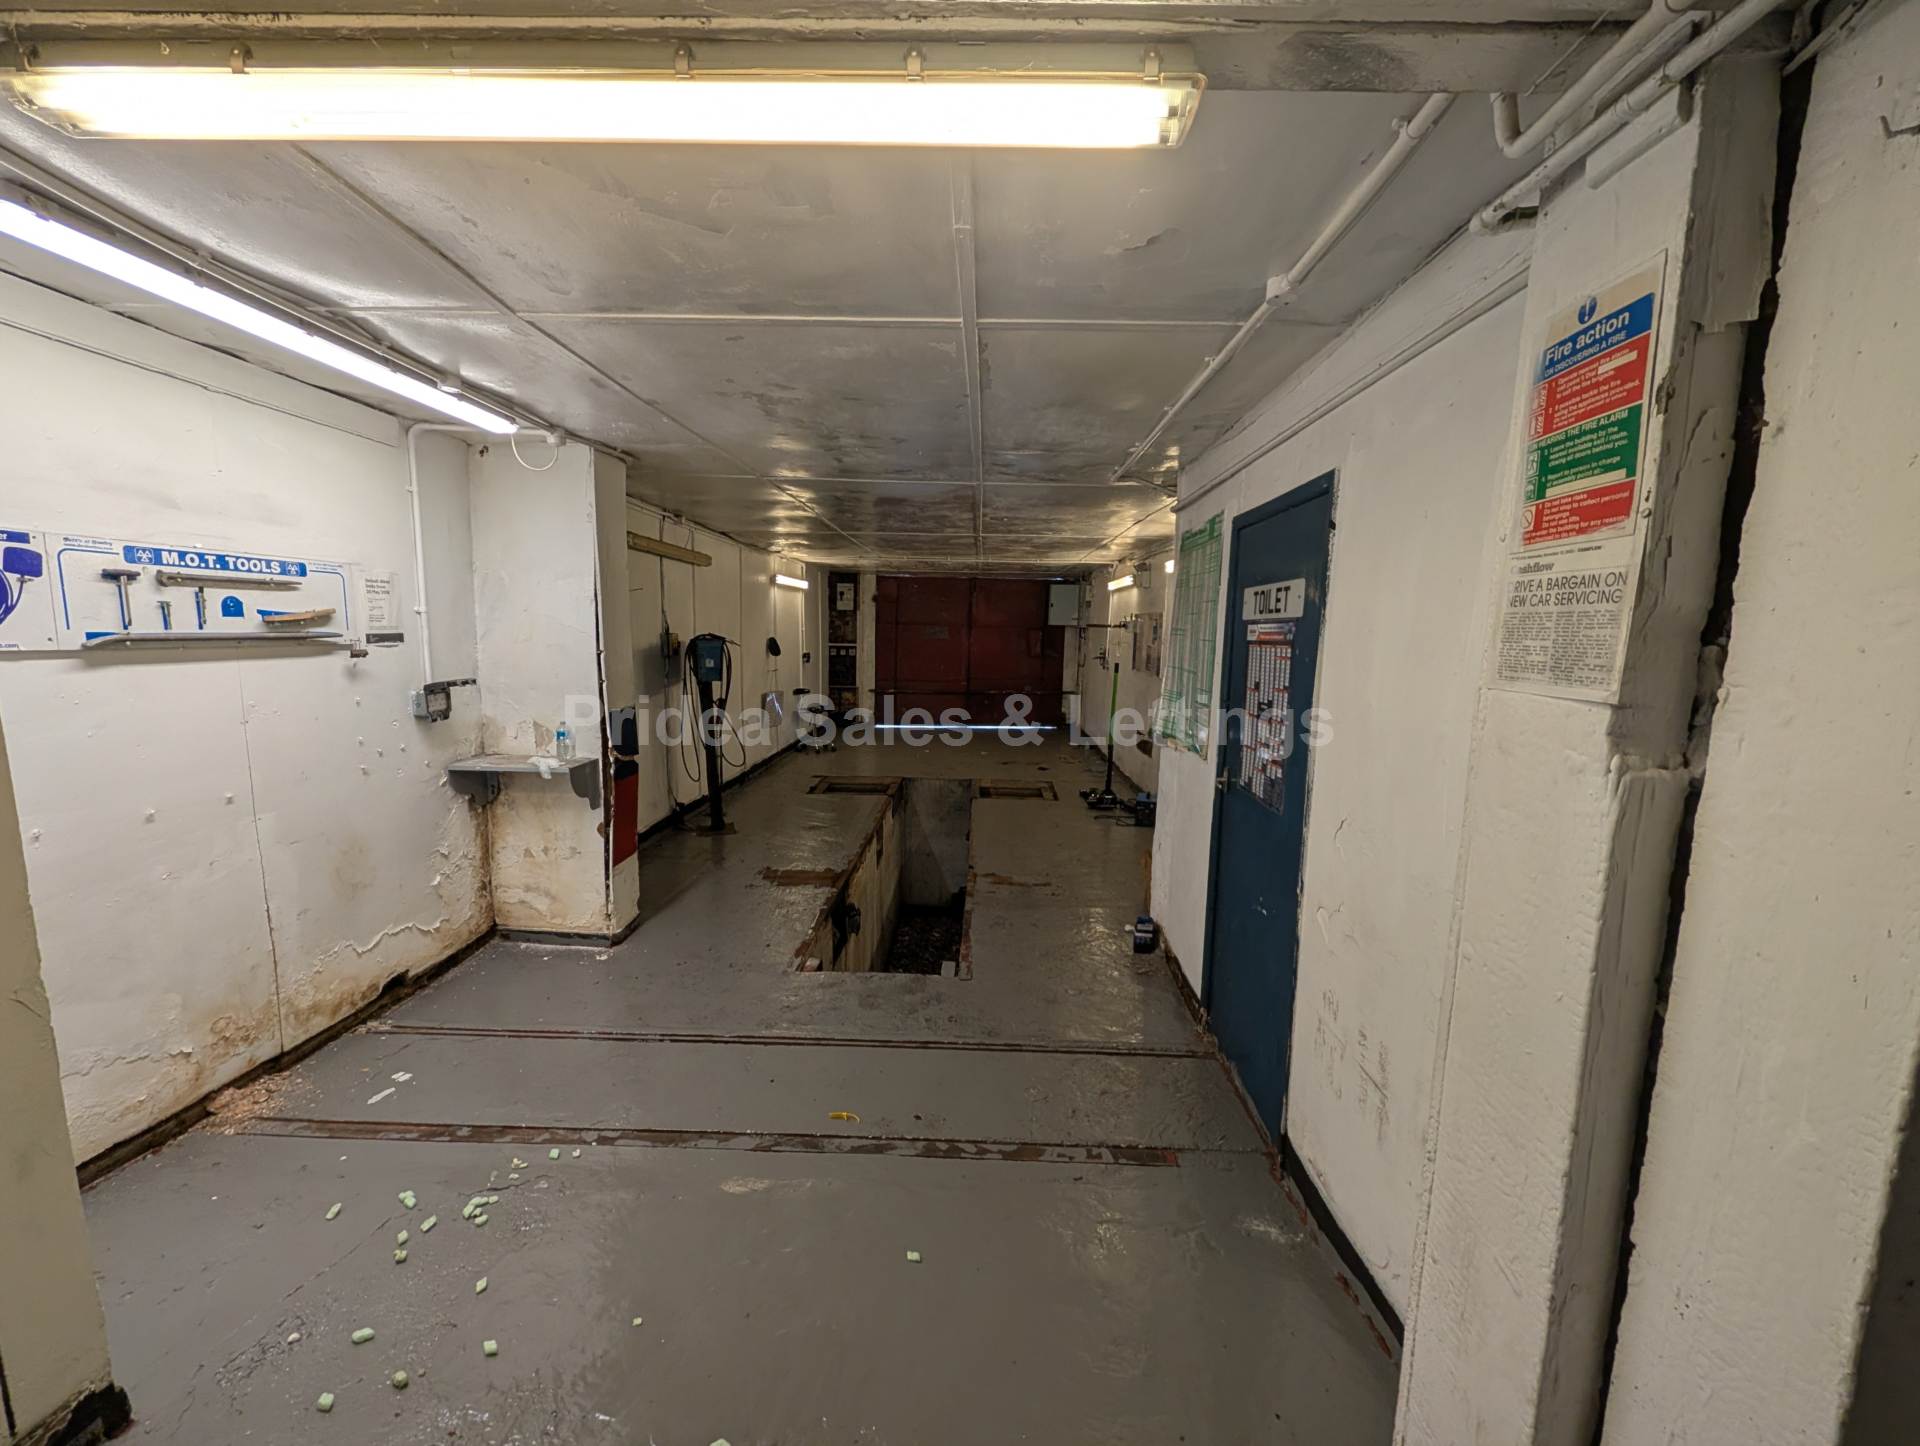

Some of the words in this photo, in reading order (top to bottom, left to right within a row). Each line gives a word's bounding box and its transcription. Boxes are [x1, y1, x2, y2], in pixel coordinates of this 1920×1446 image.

[1545, 342, 1572, 366] Fire
[1576, 312, 1629, 349] action
[1545, 367, 1554, 377] ON
[1554, 344, 1600, 374] DISCOVERING
[1600, 340, 1607, 350] A
[1607, 330, 1627, 346] FIRE
[1566, 426, 1581, 438] THE
[1581, 419, 1597, 433] FIRE
[1599, 408, 1628, 427] ALARM
[162, 551, 220, 569] M.O.T.
[225, 556, 281, 574] TOOLS
[1536, 578, 1543, 592] A
[1546, 573, 1601, 591] BARGAIN
[1604, 571, 1629, 587] ON
[1253, 585, 1291, 616] TOILET
[1529, 593, 1552, 607] CAR
[1553, 588, 1623, 607] SERVICING
